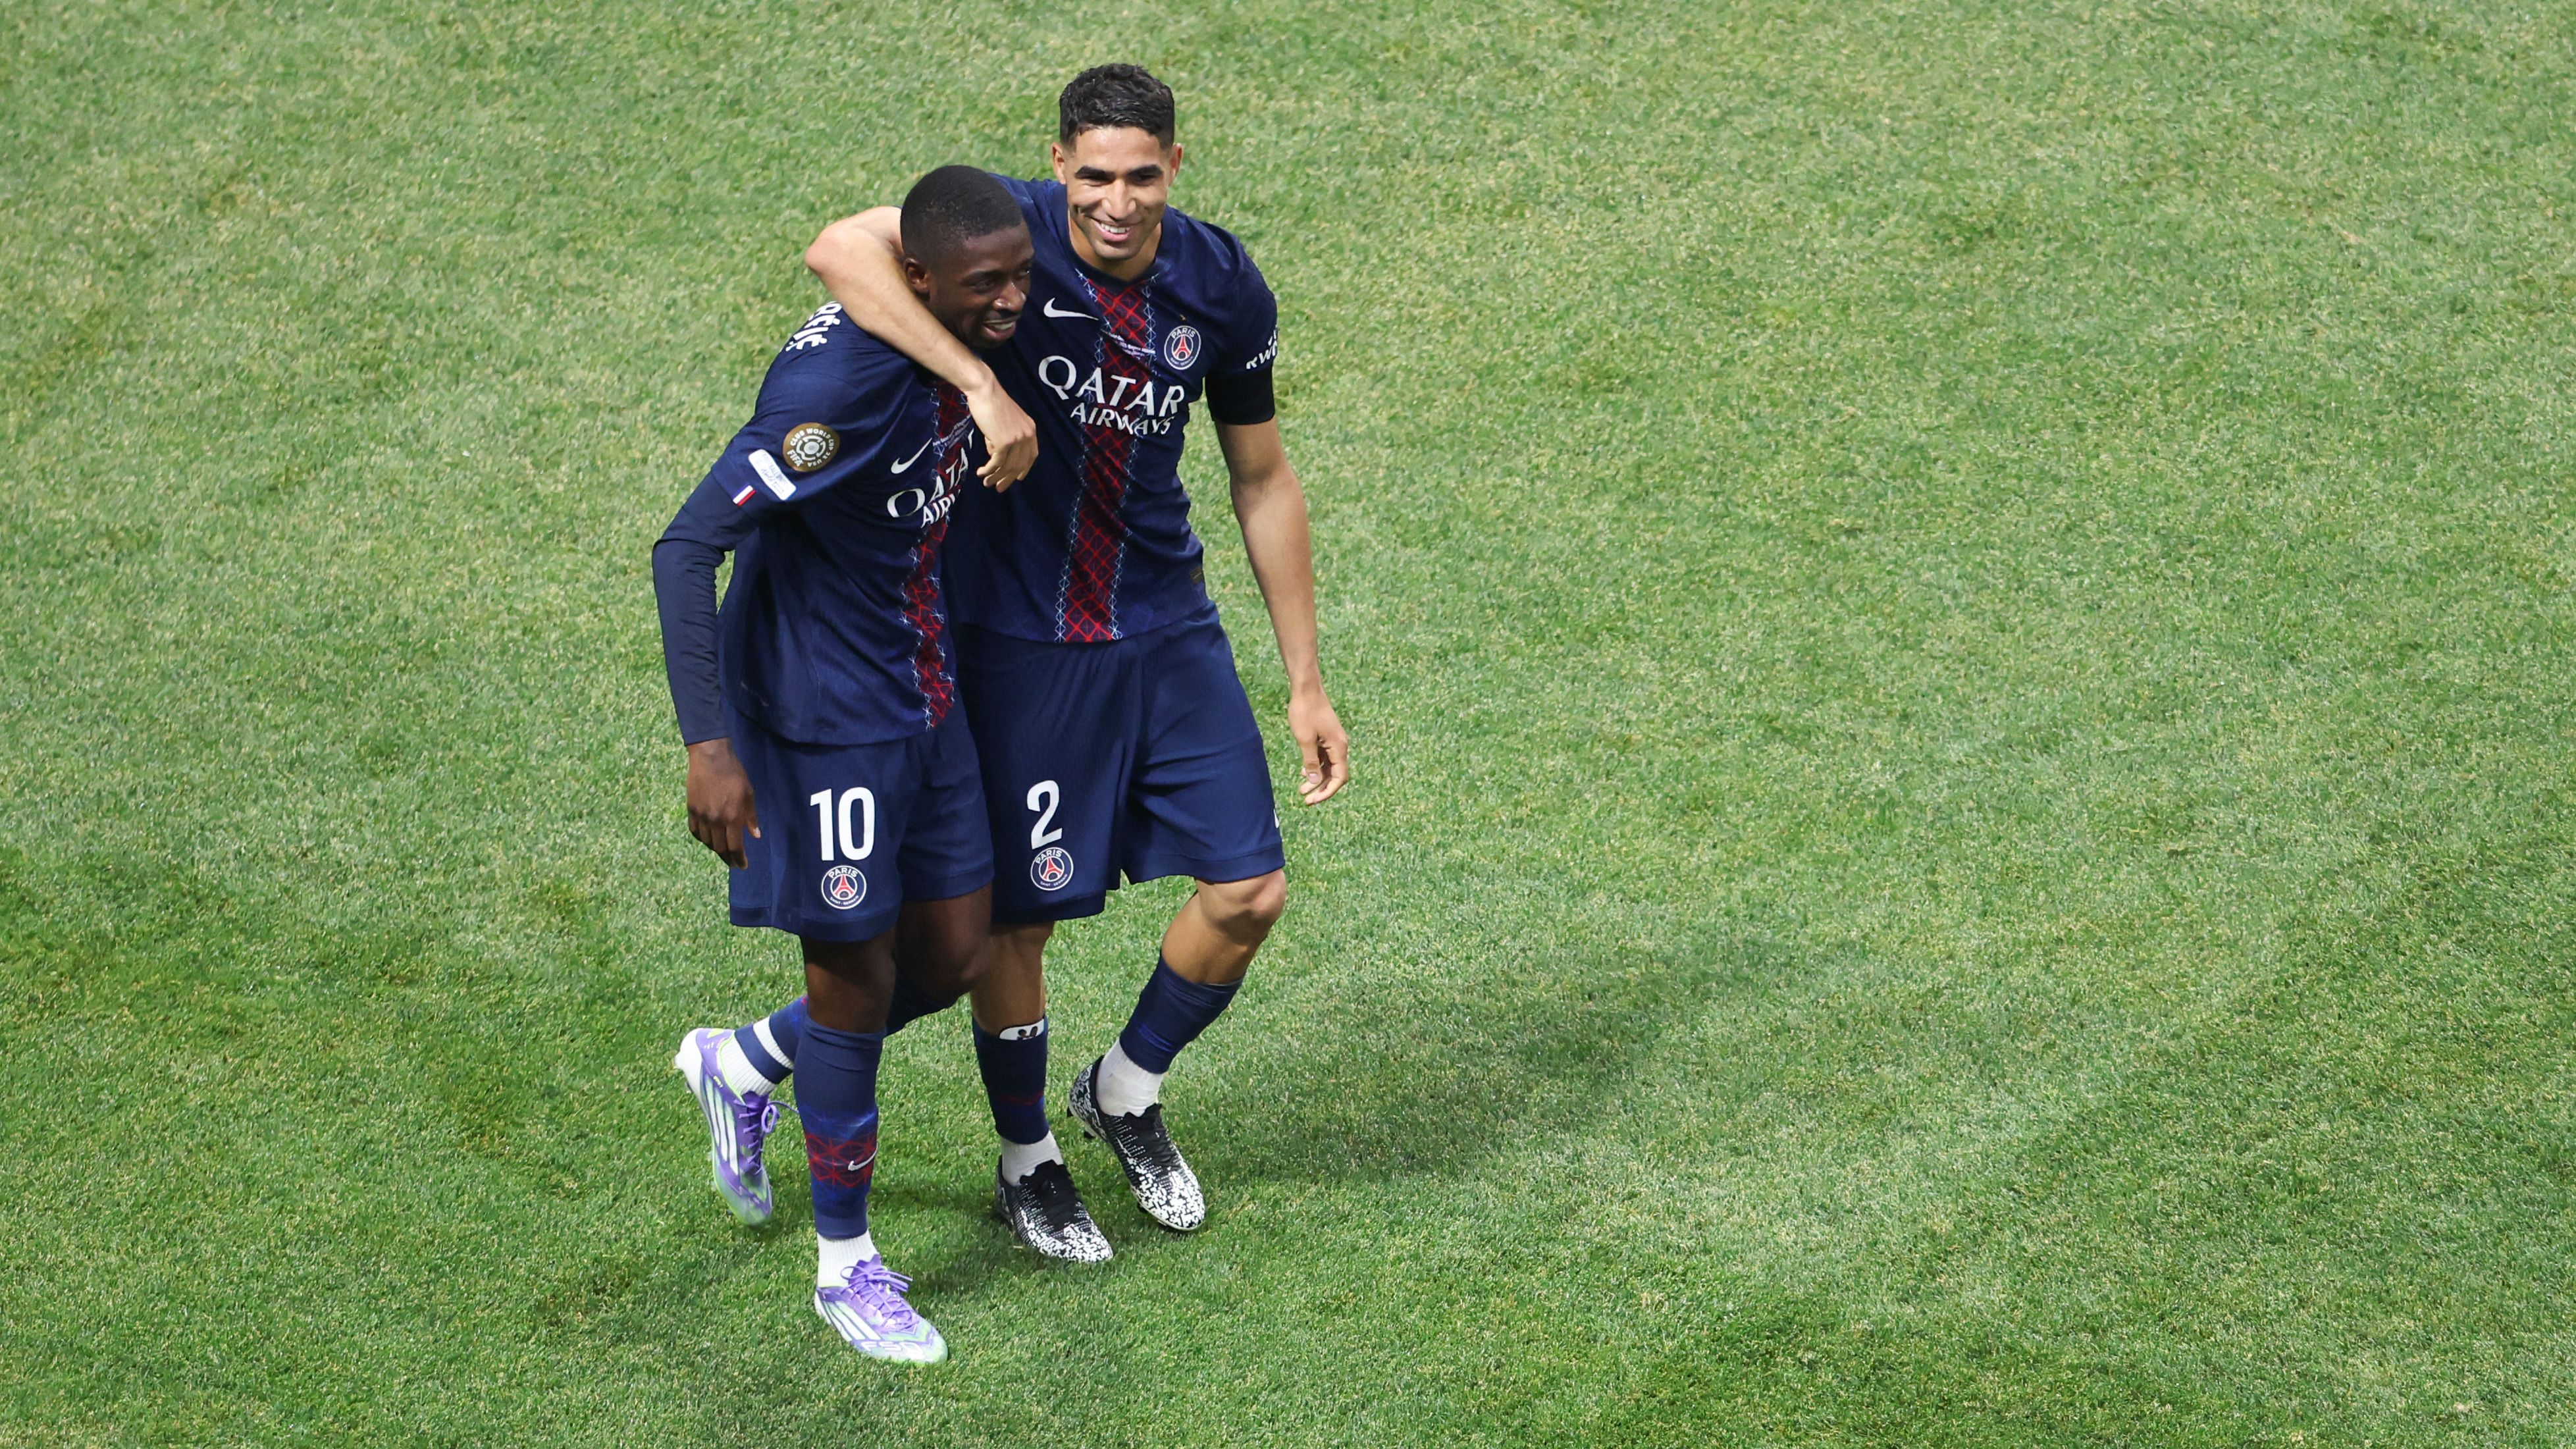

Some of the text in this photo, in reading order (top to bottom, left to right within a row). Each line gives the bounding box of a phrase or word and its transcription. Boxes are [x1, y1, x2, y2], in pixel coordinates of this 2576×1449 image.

[1171, 327, 1196, 339] PARIS
[1038, 355, 1185, 418] QATAR
[1070, 402, 1175, 436] AIRWAYS
[790, 430, 805, 446] CLUB
[806, 428, 831, 439] WORLD
[787, 449, 803, 467] FIFA
[1027, 779, 1063, 850] 2
[810, 787, 875, 861] 10
[1036, 849, 1063, 864] PARIS
[828, 867, 858, 879] PARIS
